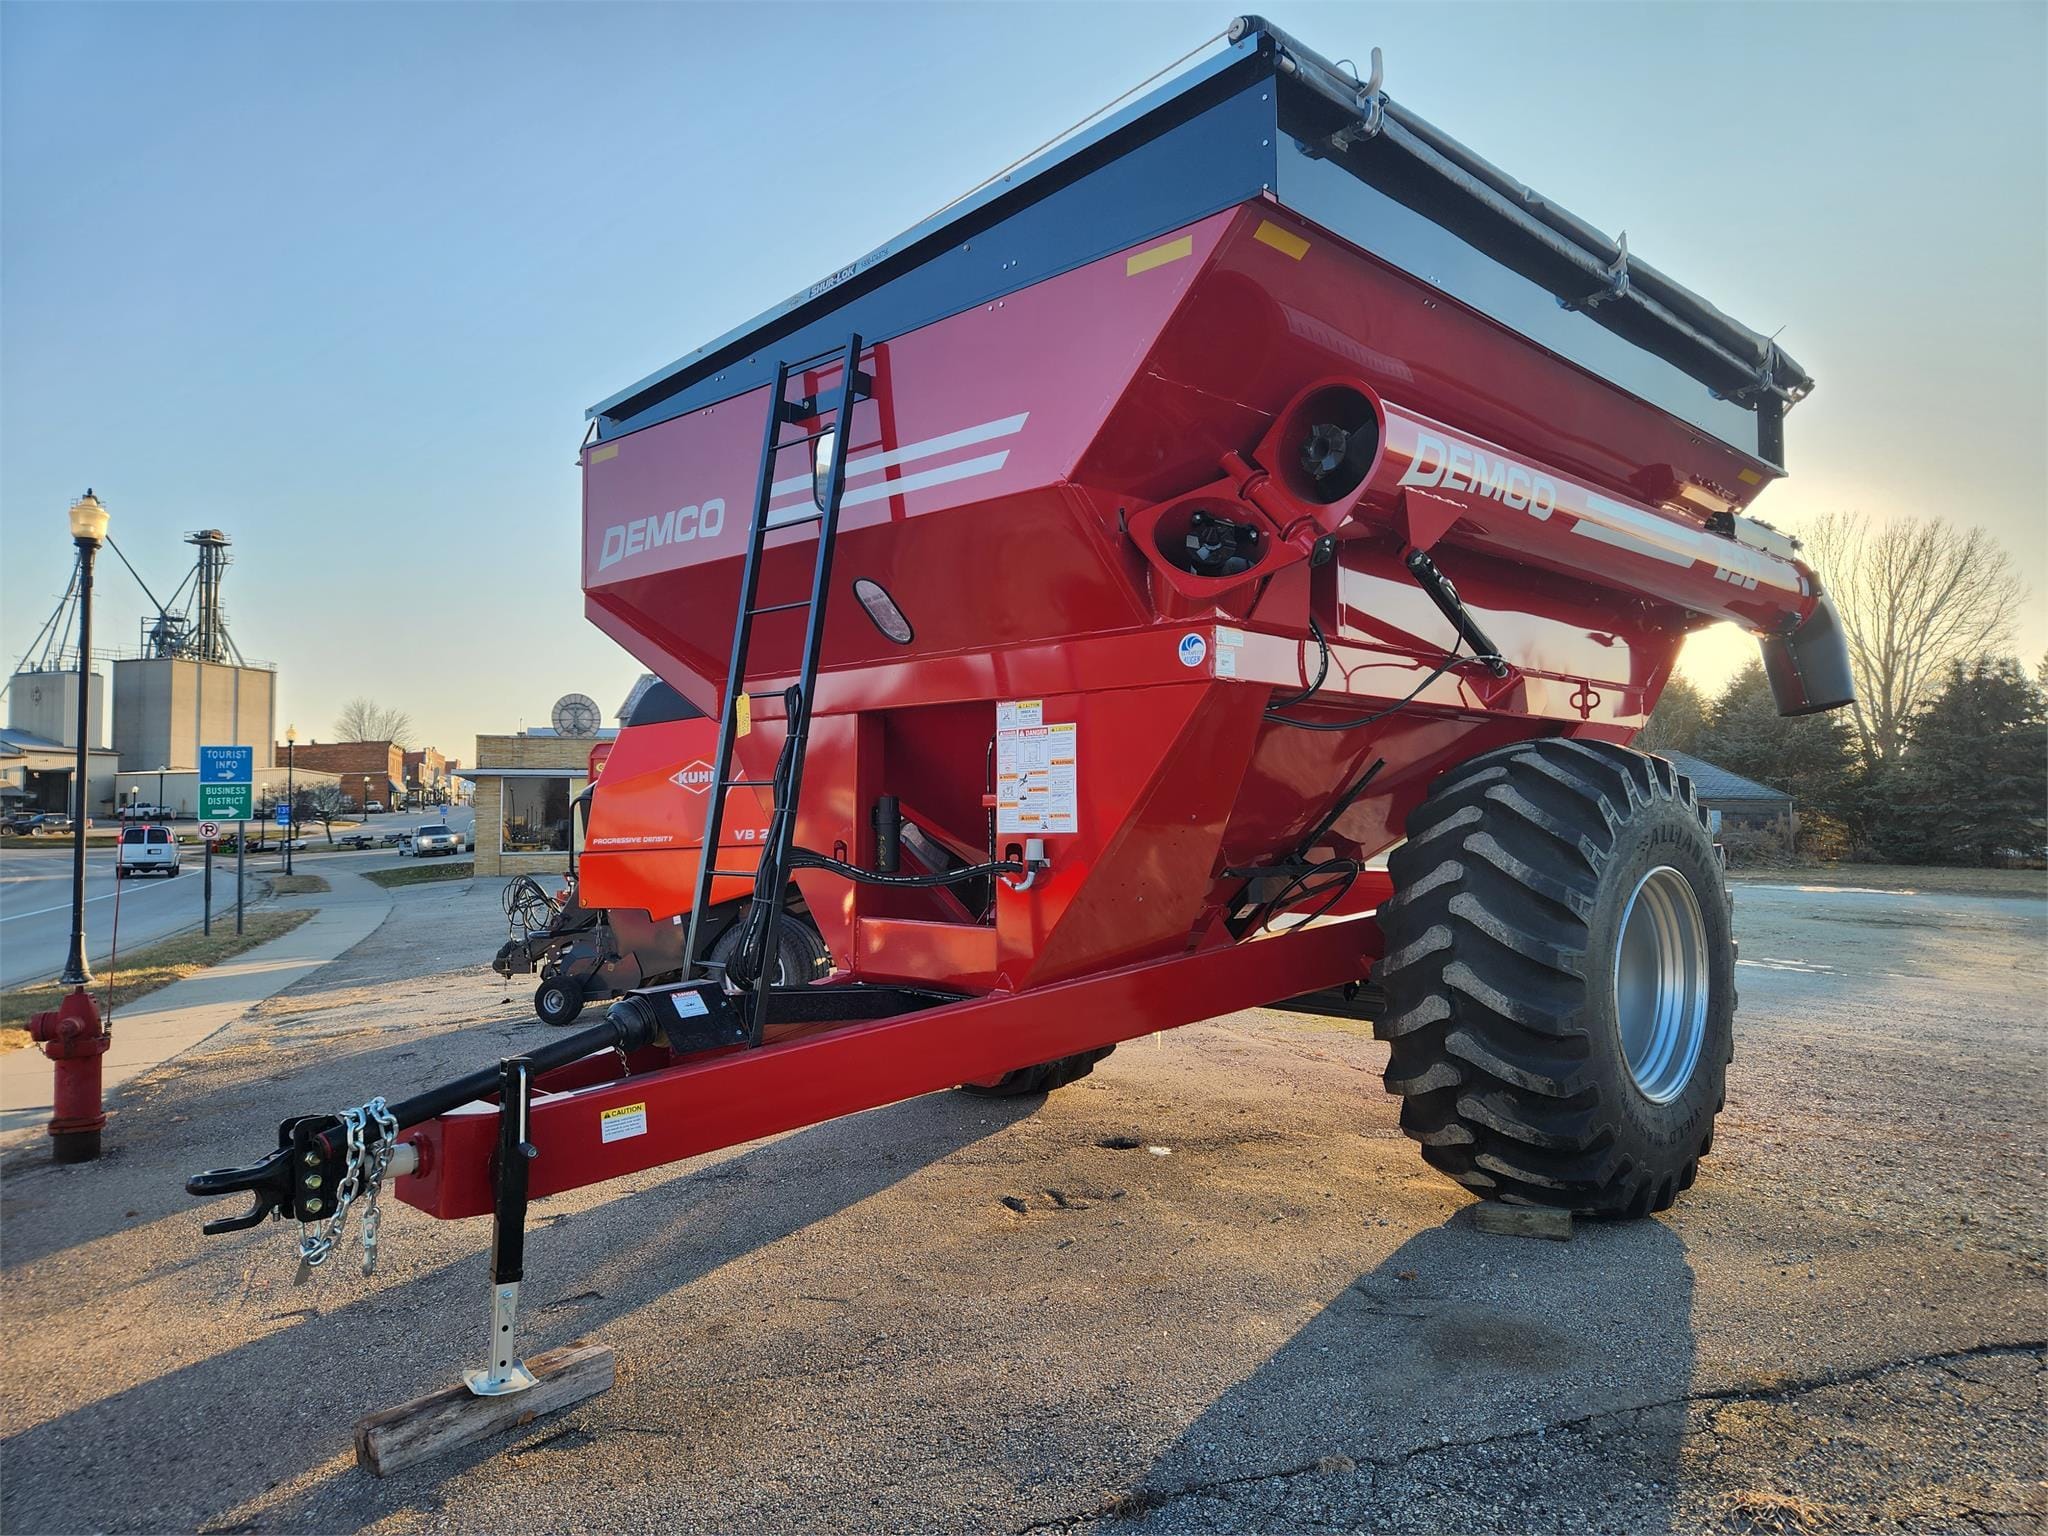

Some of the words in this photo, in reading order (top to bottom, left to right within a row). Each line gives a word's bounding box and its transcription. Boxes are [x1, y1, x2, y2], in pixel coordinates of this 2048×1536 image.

[810, 264, 855, 297] SHUR-LOK
[1396, 433, 1556, 522] DEMCO
[598, 498, 726, 572] DEMCO
[1025, 729, 1048, 737] DANGER
[207, 750, 247, 759] TOURIST
[216, 760, 238, 769] INFO
[206, 787, 246, 795] BUSINESS
[207, 797, 244, 806] DISTRICT
[735, 830, 755, 841] VB
[611, 1105, 642, 1117] CAUTION
